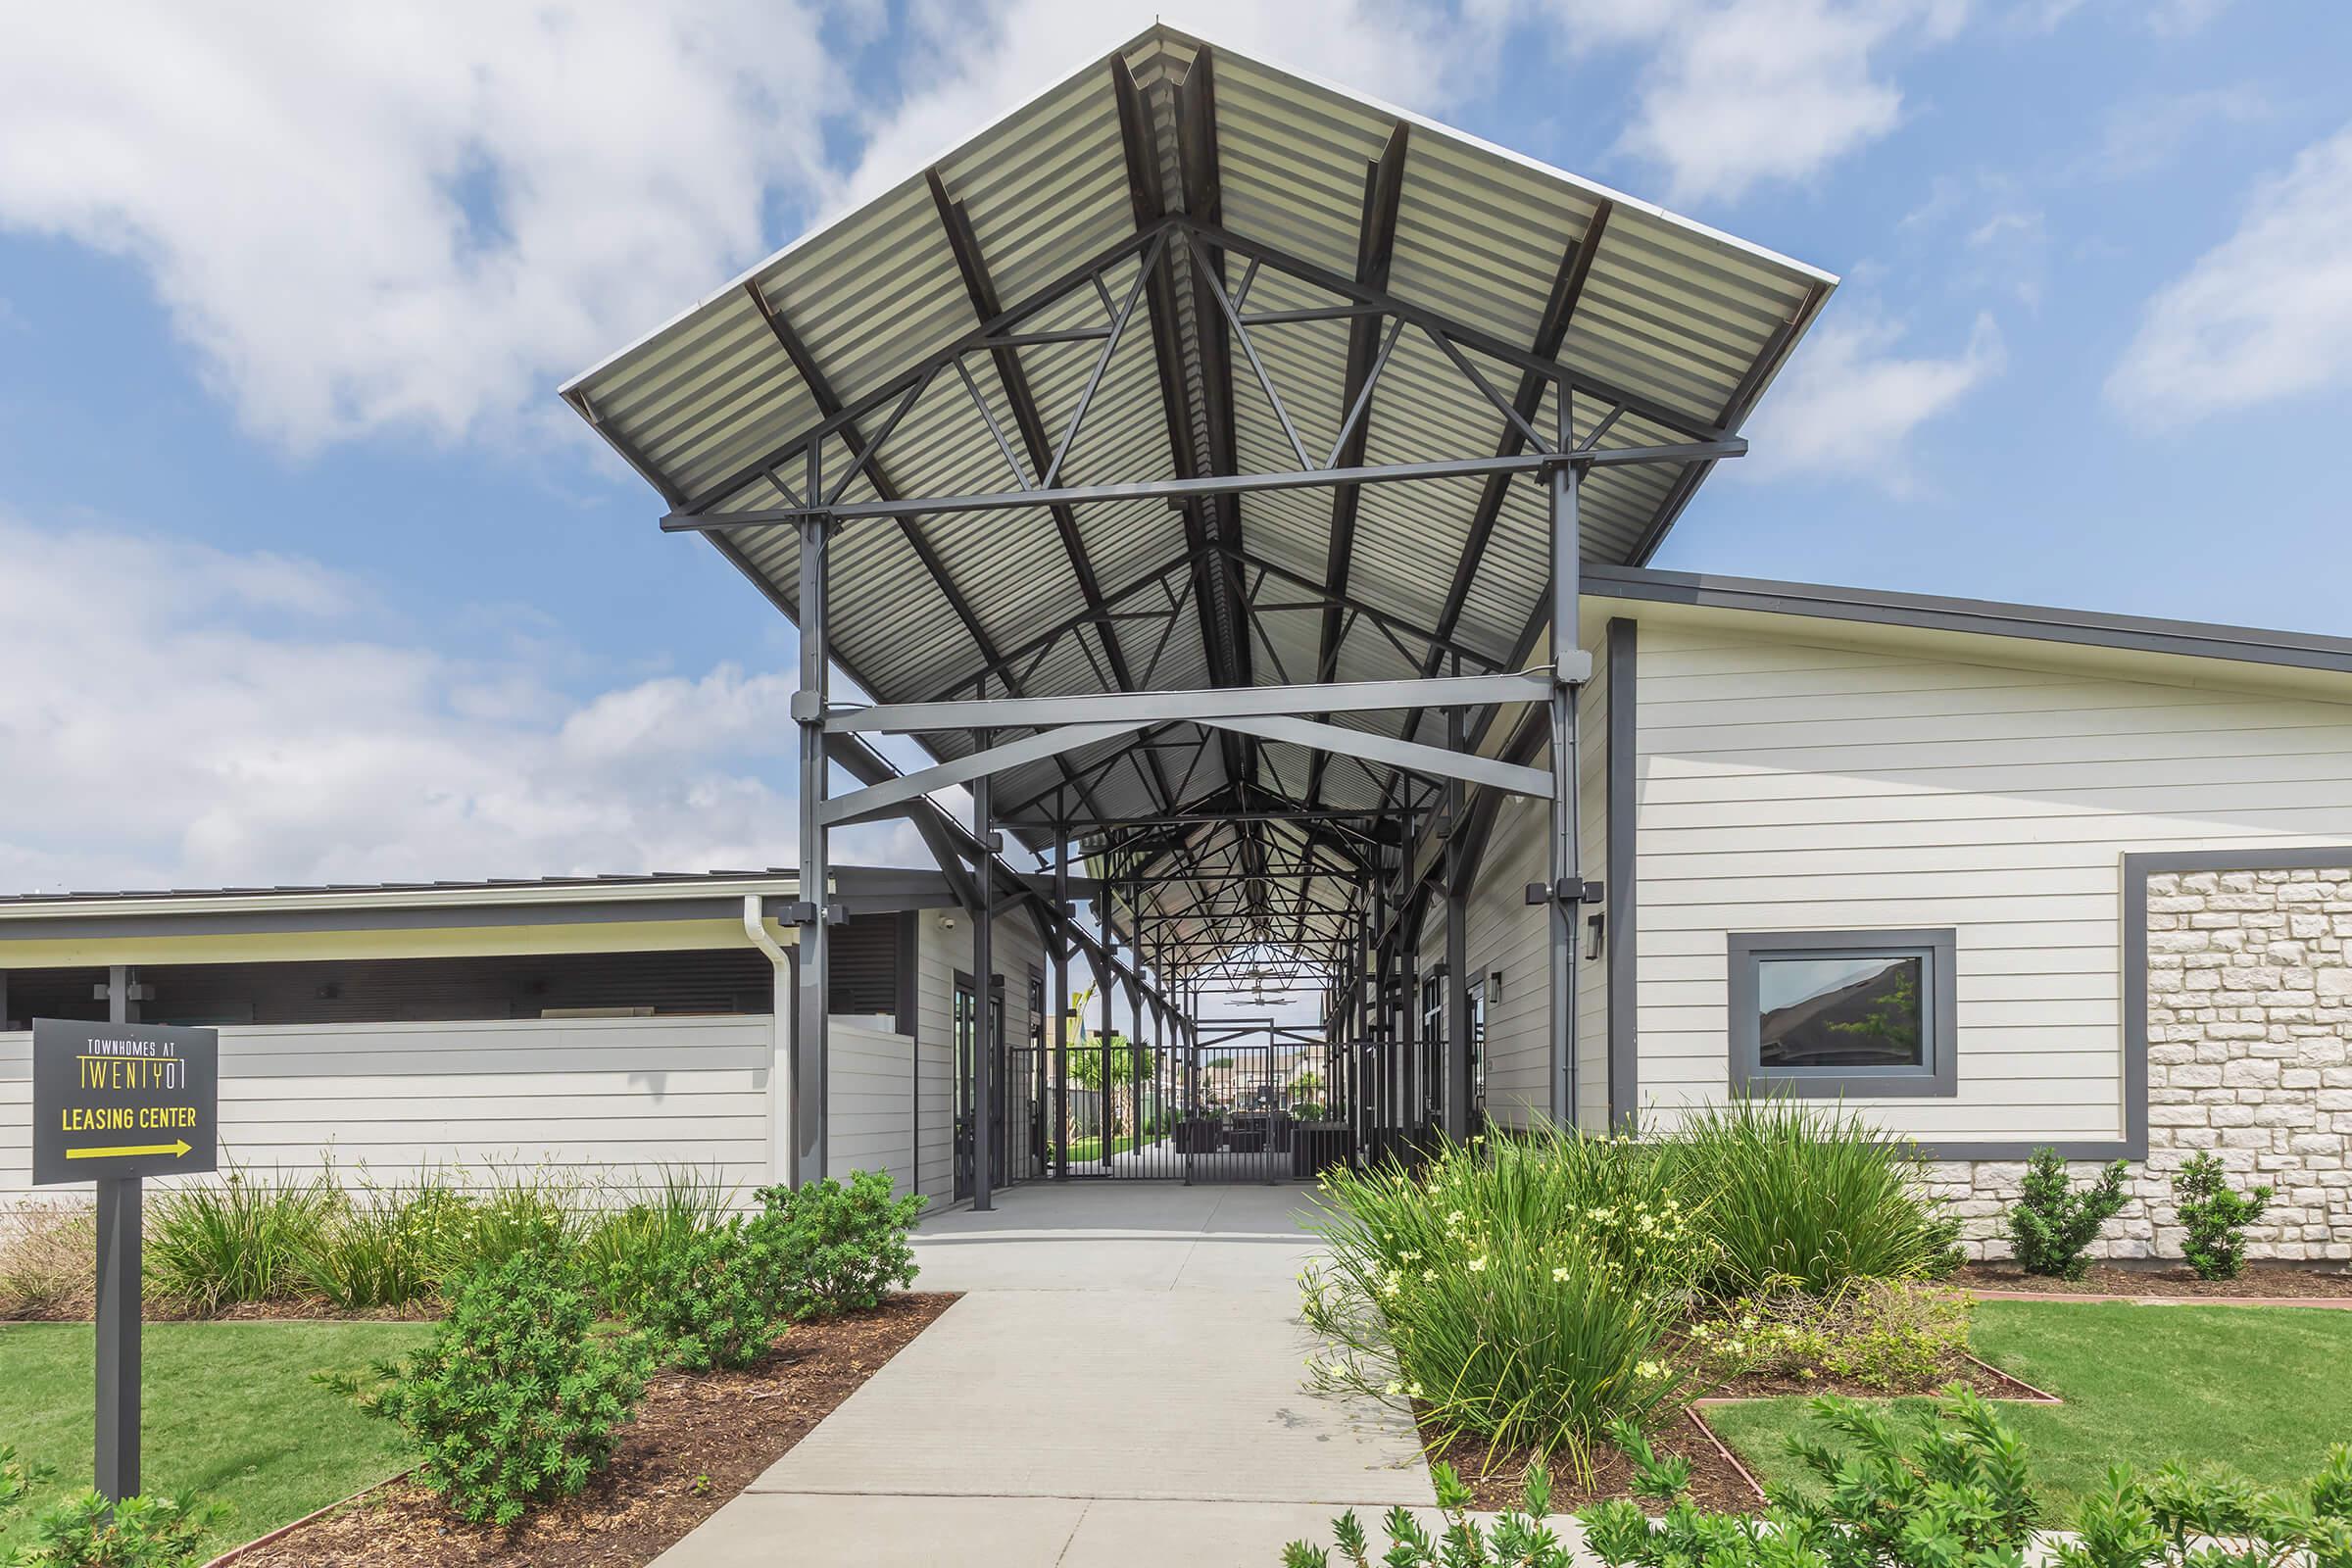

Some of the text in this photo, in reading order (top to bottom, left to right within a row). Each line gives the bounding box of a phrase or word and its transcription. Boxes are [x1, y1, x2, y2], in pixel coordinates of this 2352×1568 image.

[88, 1039, 174, 1056] TOWNHOMES AT
[62, 1107, 196, 1131] LEASING CENTER
